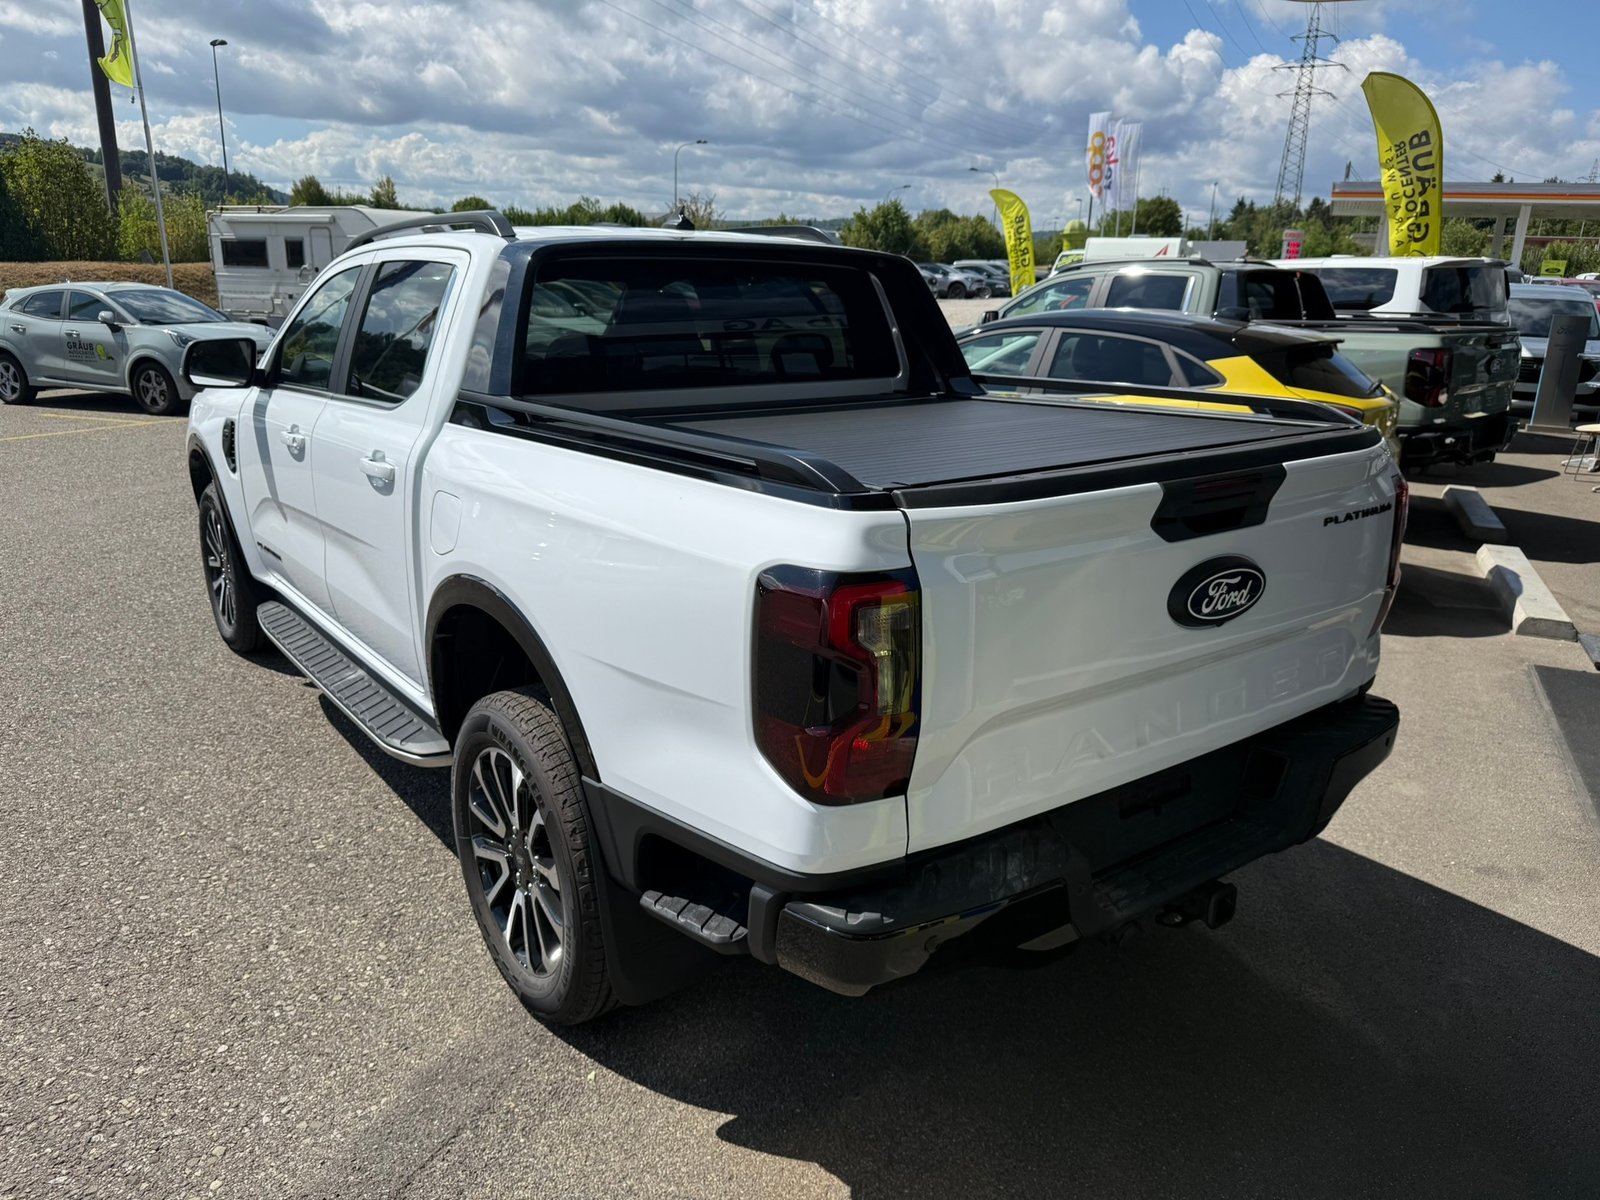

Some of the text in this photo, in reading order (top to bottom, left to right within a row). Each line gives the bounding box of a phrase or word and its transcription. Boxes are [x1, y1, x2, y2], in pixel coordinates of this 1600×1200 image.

[66, 341, 94, 351] GRÄUB
[1323, 502, 1392, 528] PLATINUM
[1201, 575, 1253, 614] Ford
